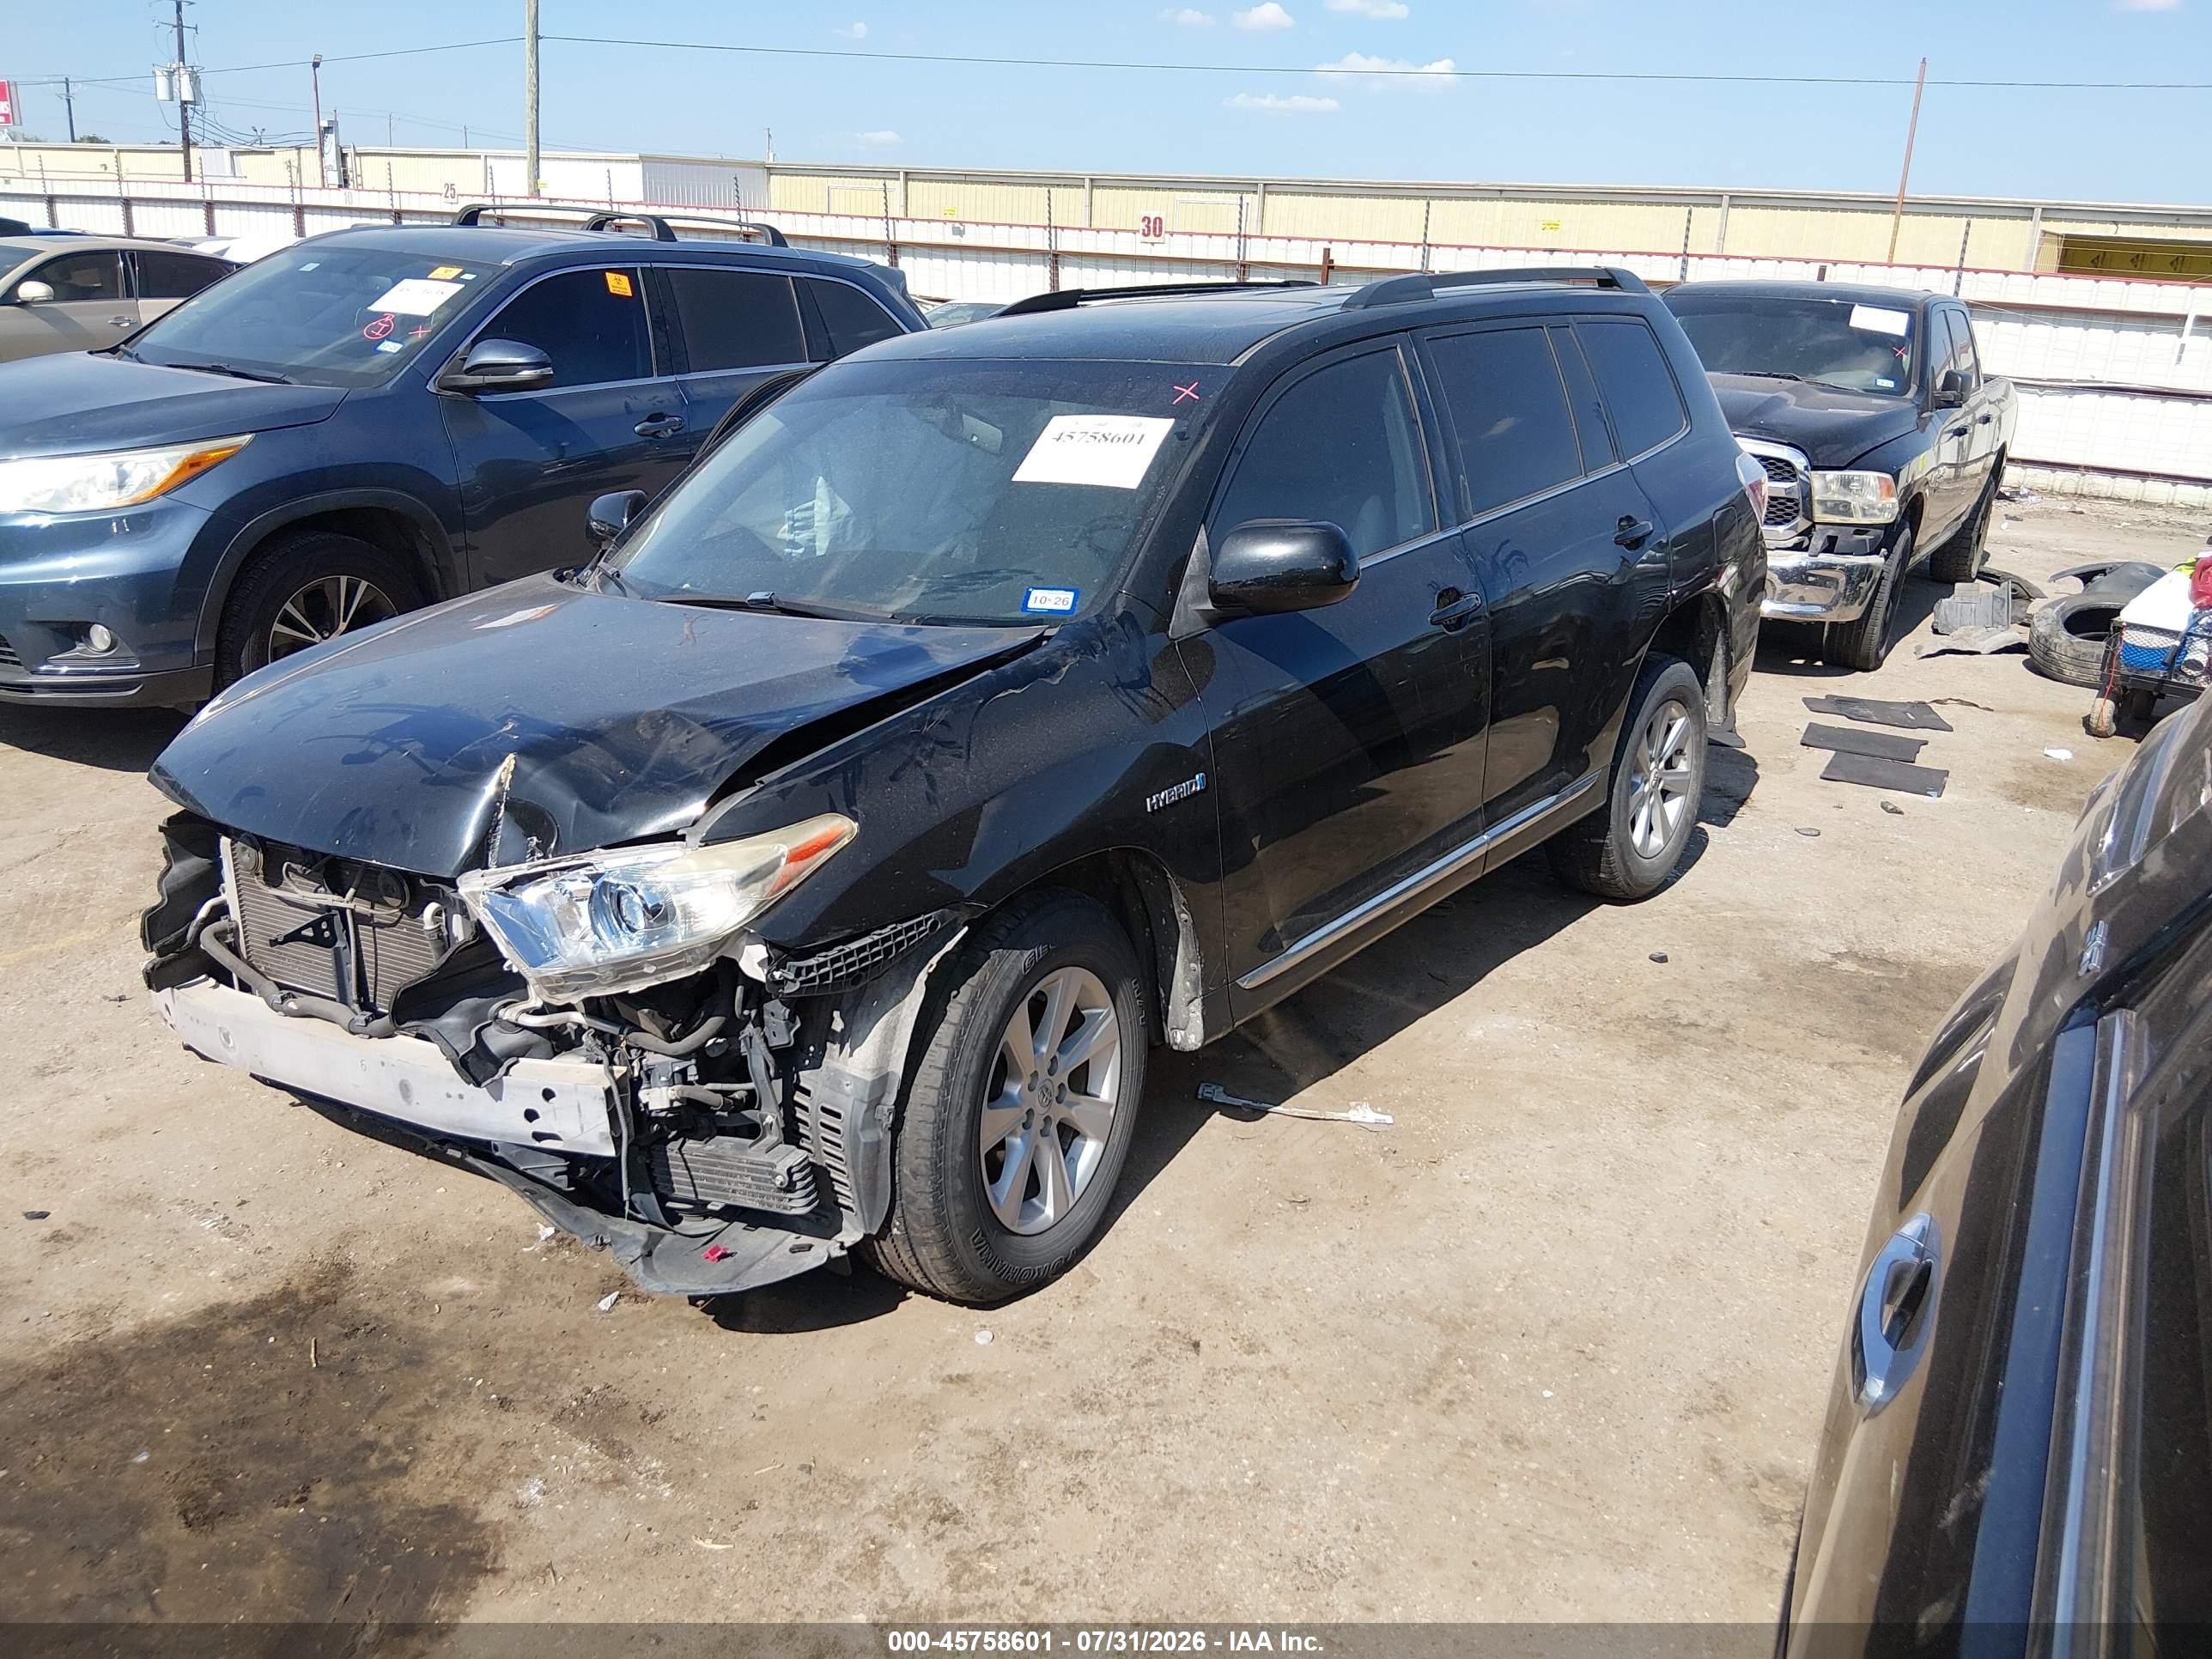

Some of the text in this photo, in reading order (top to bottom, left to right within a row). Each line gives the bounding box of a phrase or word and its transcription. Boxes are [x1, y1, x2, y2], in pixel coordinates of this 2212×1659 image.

[443, 182, 456, 199] 25
[1141, 216, 1164, 238] 30
[1052, 431, 1146, 445] 45758601
[1146, 779, 1197, 812] HYBRID
